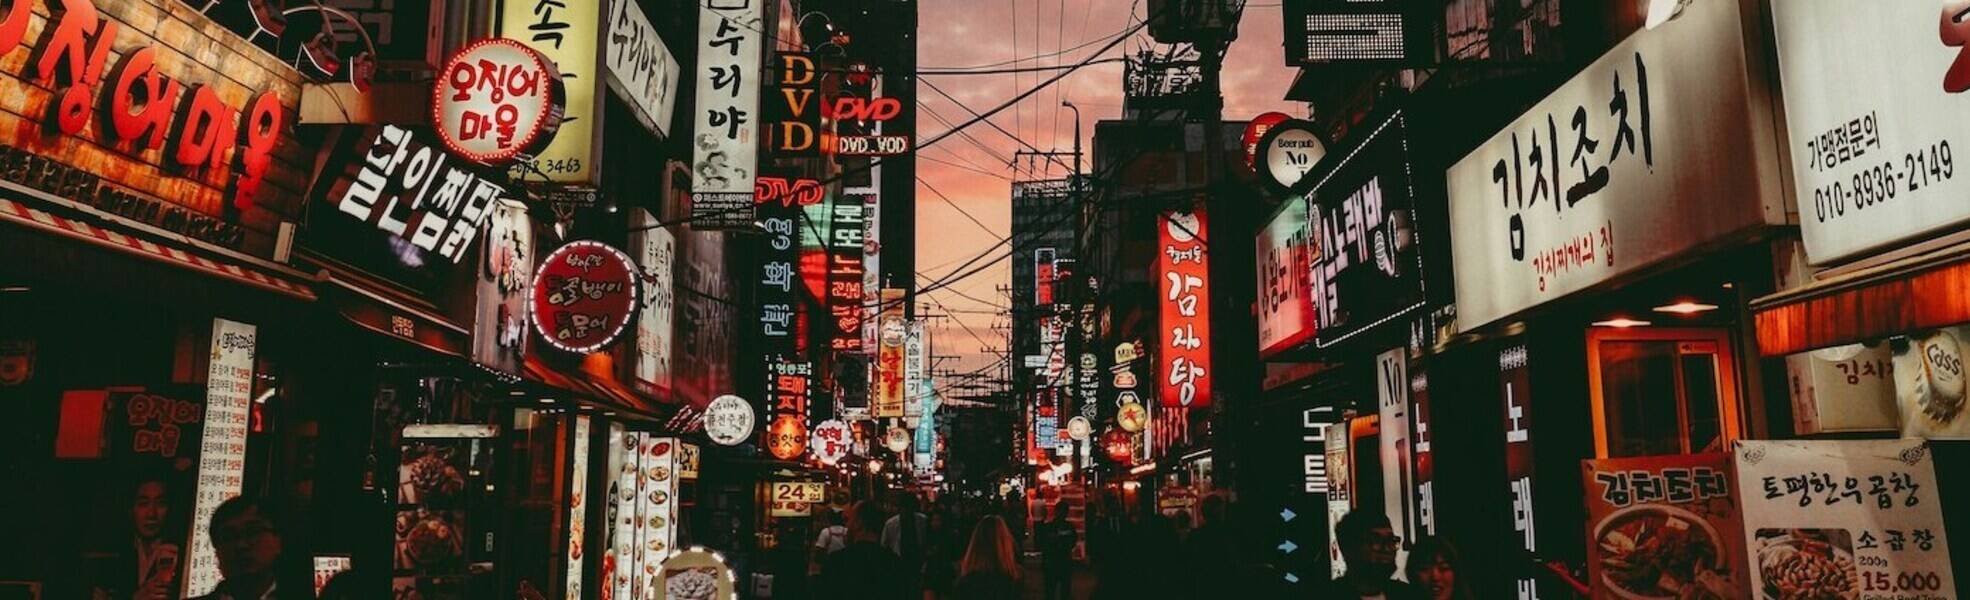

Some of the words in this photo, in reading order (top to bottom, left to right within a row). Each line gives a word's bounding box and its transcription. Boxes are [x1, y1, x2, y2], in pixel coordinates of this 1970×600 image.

[450, 59, 540, 104] 오징어
[708, 17, 747, 139] 수리야
[781, 55, 817, 152] DVD
[833, 97, 902, 121] DVD
[459, 104, 519, 149] 마을
[1278, 139, 1298, 148] Beer
[1298, 139, 1314, 149] pub
[1807, 110, 1881, 172] 가맹점문의
[546, 157, 582, 173] 3463
[1285, 151, 1308, 165] No
[1492, 51, 1653, 262] 김치조치
[339, 124, 501, 264] 달인찜닭
[755, 177, 825, 208] DVD
[1815, 139, 1954, 223] 010-8936-2149
[1533, 231, 1595, 292] 김치찌개의
[1600, 219, 1615, 267] 집
[1167, 270, 1206, 407] 감자탕
[1926, 343, 1962, 377] Cass
[1384, 357, 1402, 407] No
[778, 484, 805, 500] 24
[1858, 556, 1888, 568] 200g
[1862, 571, 1941, 593] 15,000
